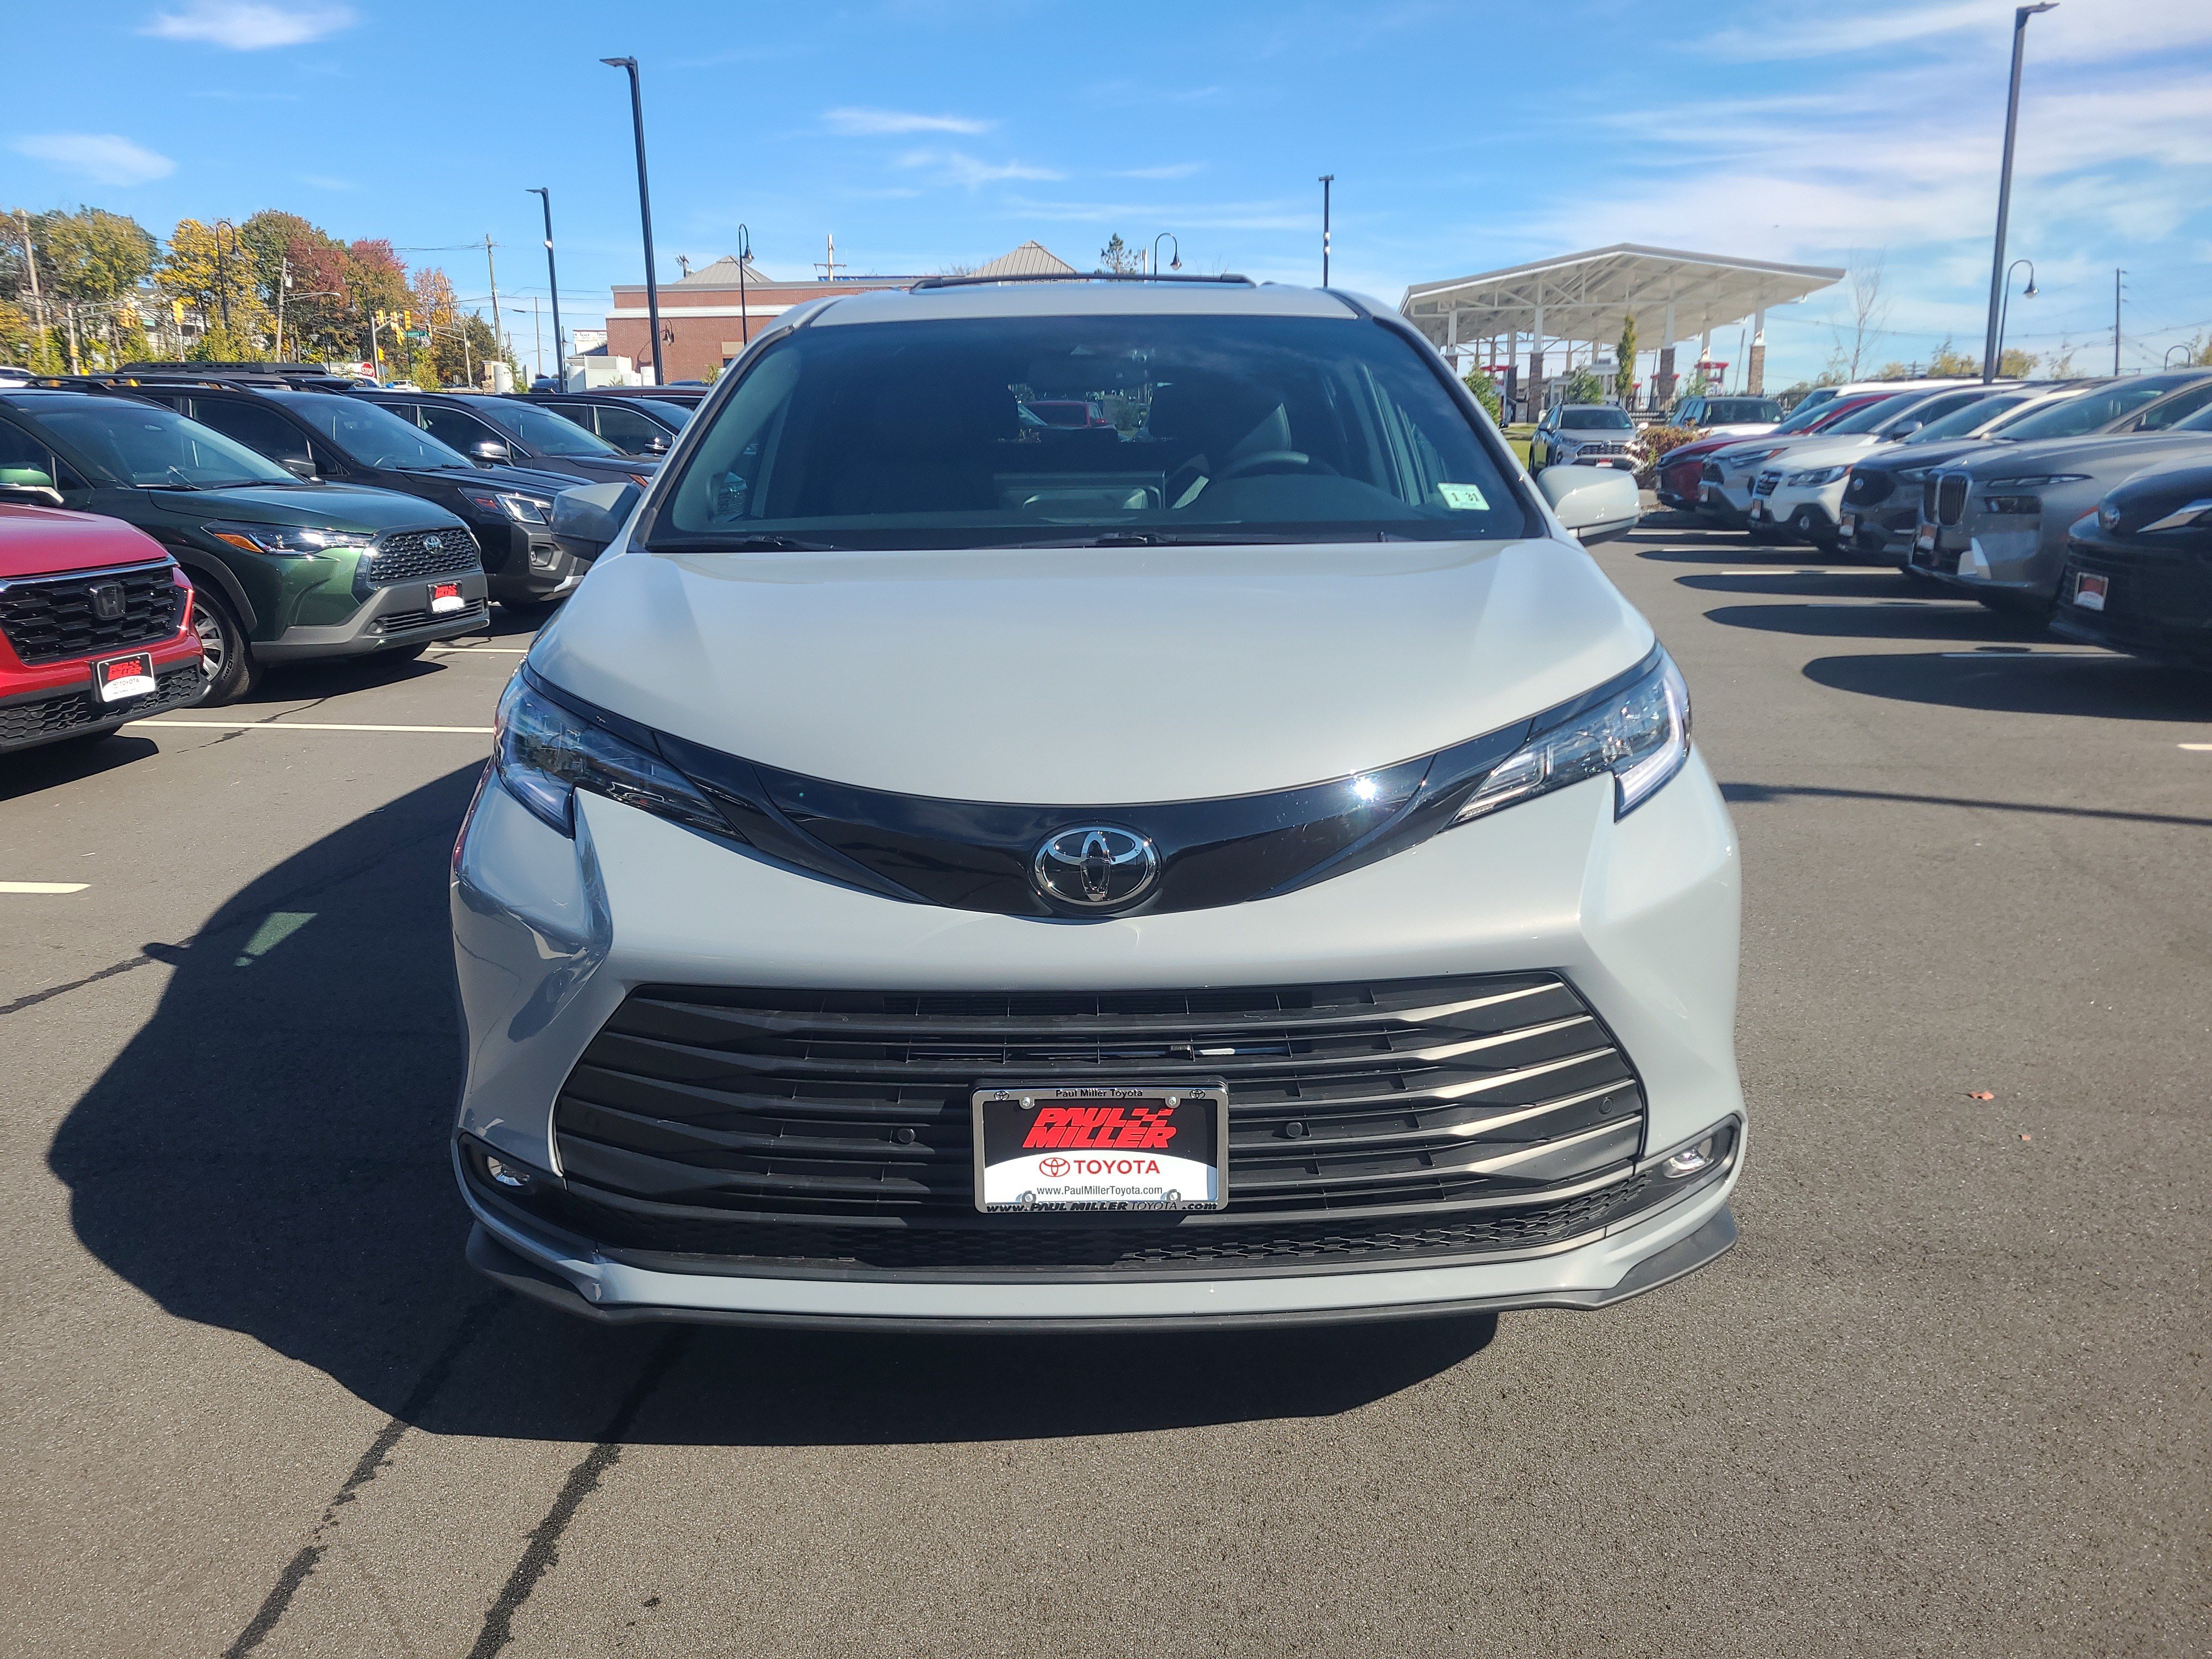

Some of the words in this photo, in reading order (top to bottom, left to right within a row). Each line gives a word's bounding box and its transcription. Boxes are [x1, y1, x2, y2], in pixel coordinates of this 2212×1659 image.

[1056, 1089, 1077, 1097] Paul
[1081, 1088, 1107, 1097] Miller
[1110, 1088, 1143, 1098] Toyota
[1034, 1108, 1125, 1127] PAUL
[1022, 1127, 1177, 1148] MILLER
[1074, 1160, 1160, 1174] TOYOTA
[1037, 1186, 1163, 1196] www.PaulMillerToyota.com
[1070, 1201, 1128, 1211] MILLER
[1131, 1201, 1177, 1210] TOYOTA
[1182, 1202, 1218, 1210] .com
